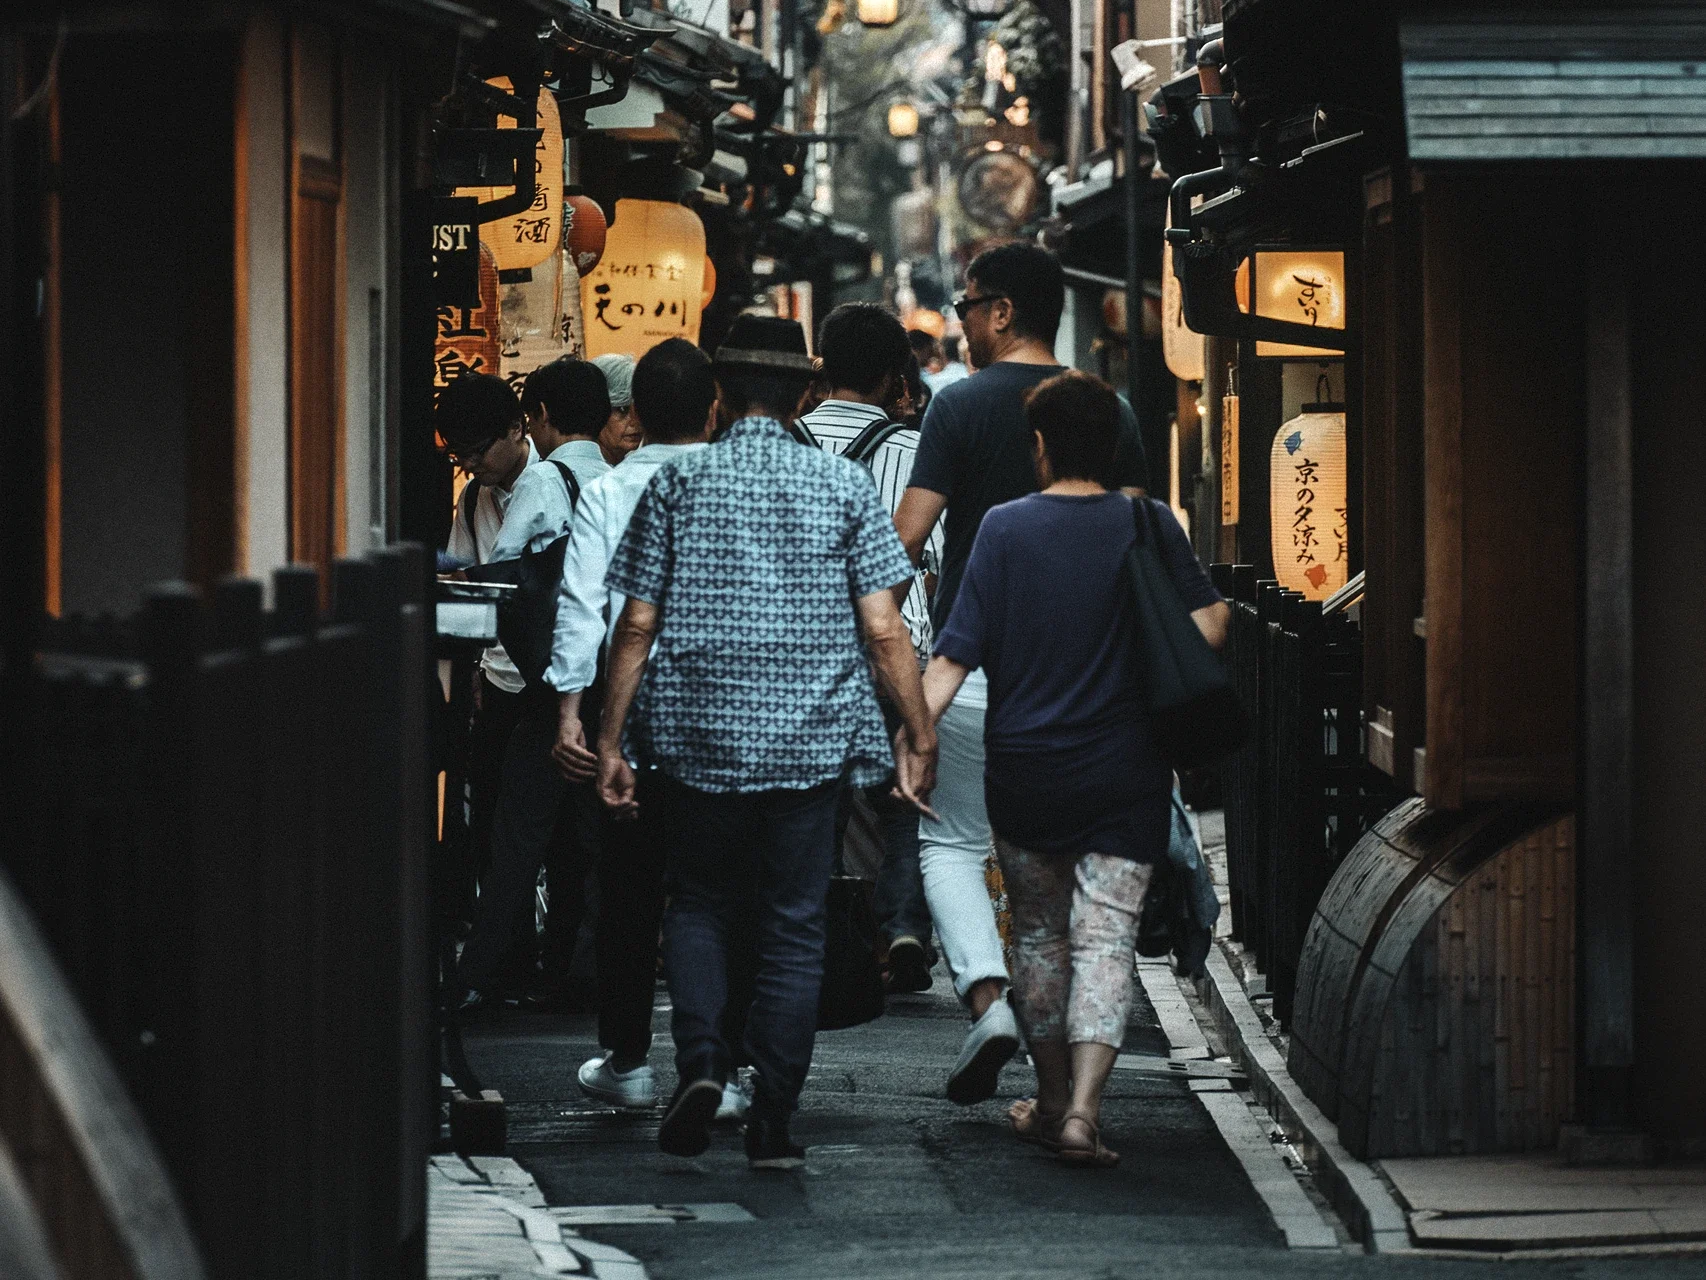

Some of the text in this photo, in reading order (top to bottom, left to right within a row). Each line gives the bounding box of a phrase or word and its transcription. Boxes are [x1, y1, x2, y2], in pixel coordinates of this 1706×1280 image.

[594, 284, 686, 331] 天の川
[1292, 457, 1319, 565] 京の夕涼み
